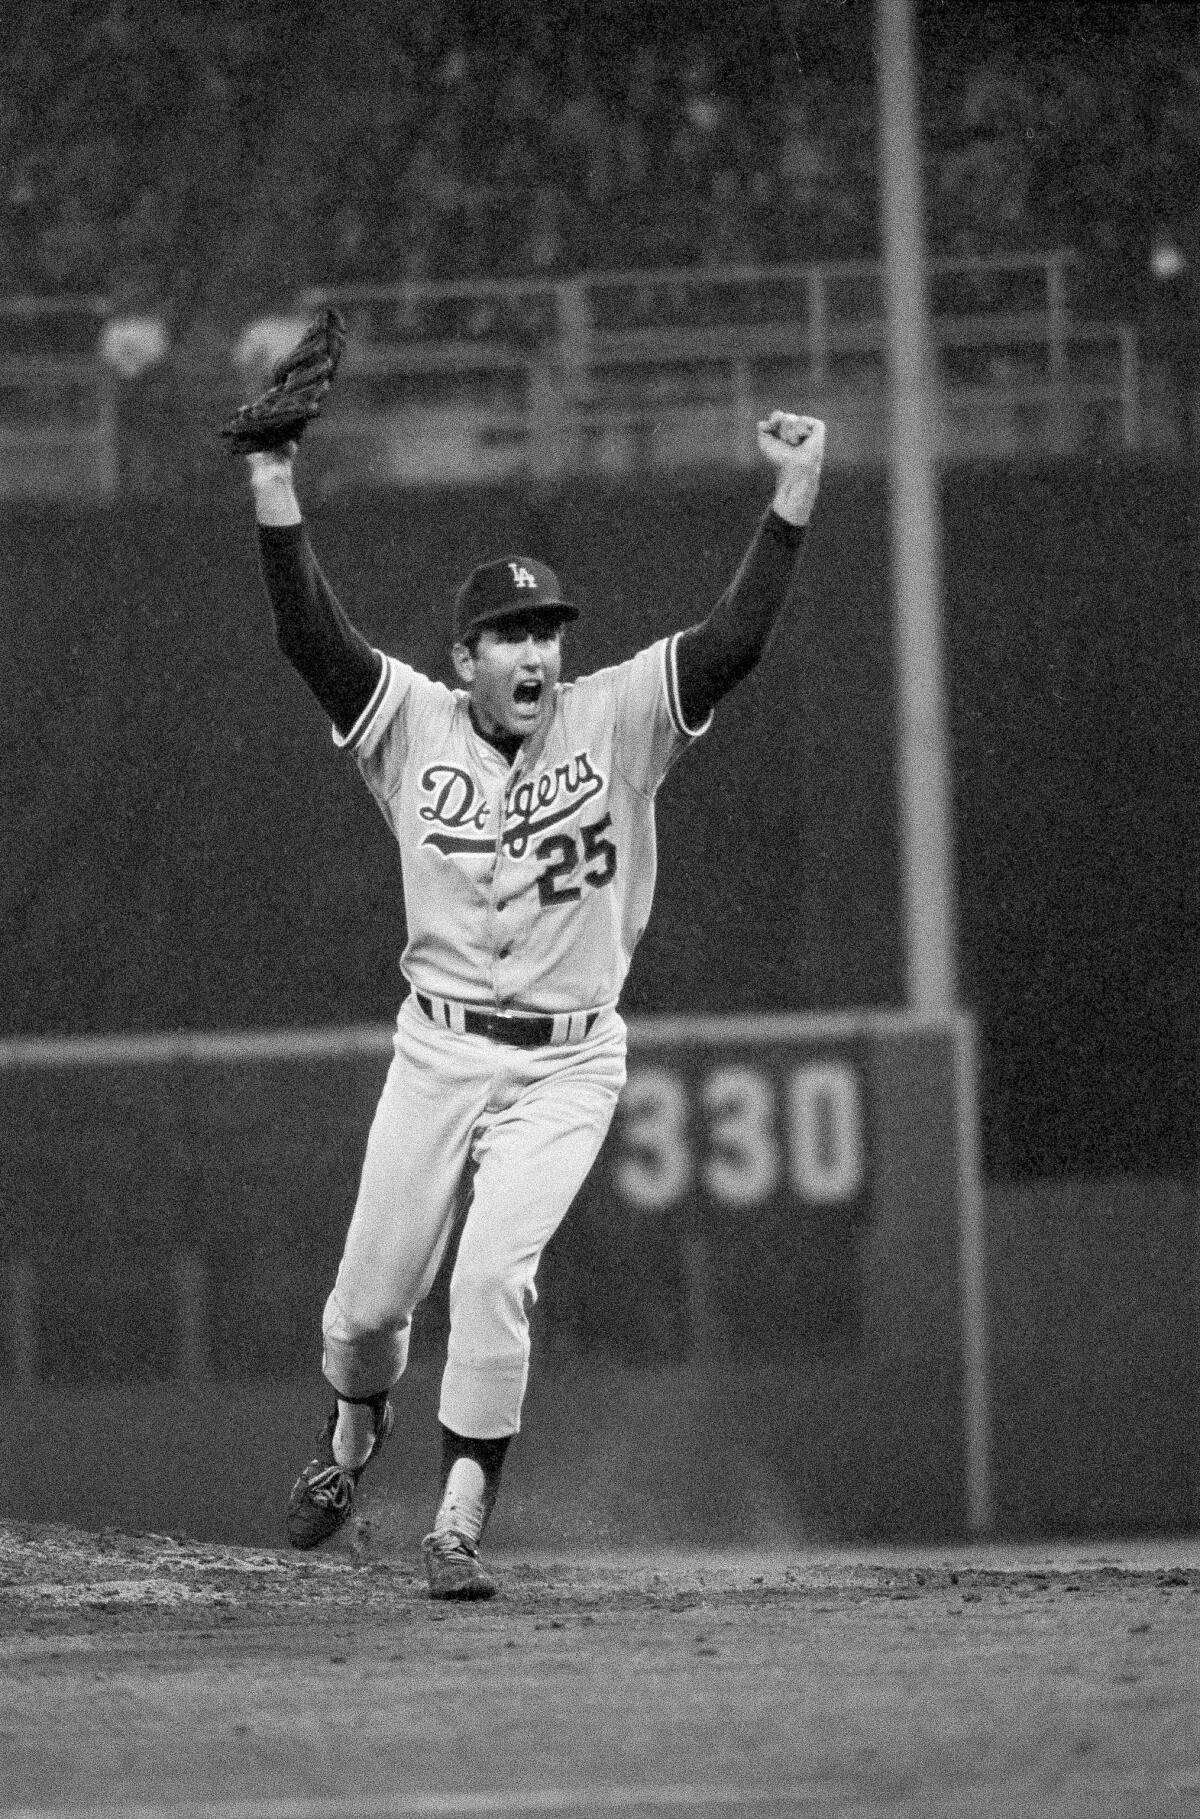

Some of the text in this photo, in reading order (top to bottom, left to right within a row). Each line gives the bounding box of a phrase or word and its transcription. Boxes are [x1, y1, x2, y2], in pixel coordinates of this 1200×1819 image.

[508, 562, 538, 589] LA
[419, 752, 604, 859] Dogers
[535, 811, 617, 907] 25
[614, 1062, 864, 1206] 330
